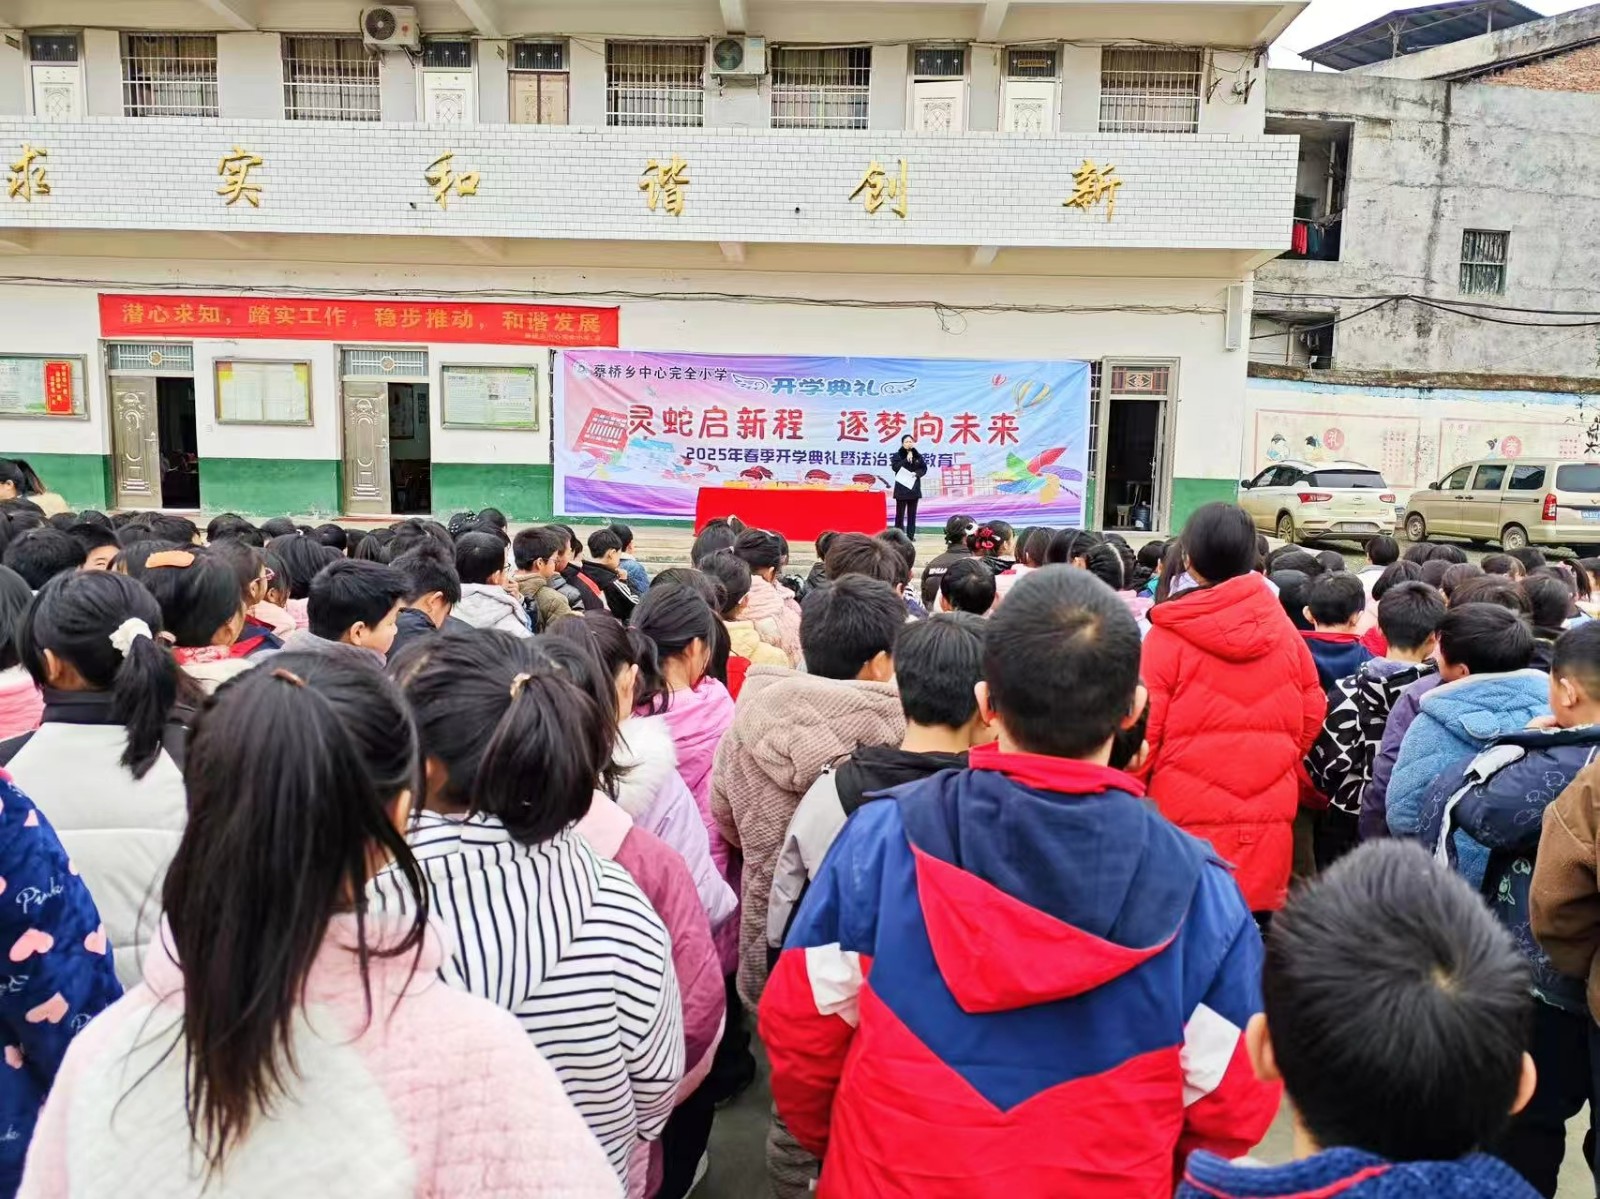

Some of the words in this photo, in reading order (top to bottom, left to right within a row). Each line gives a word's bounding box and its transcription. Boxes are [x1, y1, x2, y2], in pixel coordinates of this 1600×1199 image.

[595, 364, 728, 381] 蔡桥乡中心完全小学
[772, 378, 879, 396] 开学典礼
[628, 405, 803, 440] 灵蛇启新程
[837, 410, 1019, 444] 逐梦向未来
[686, 447, 953, 468] 2025年春季开学典礼暨法治教育
